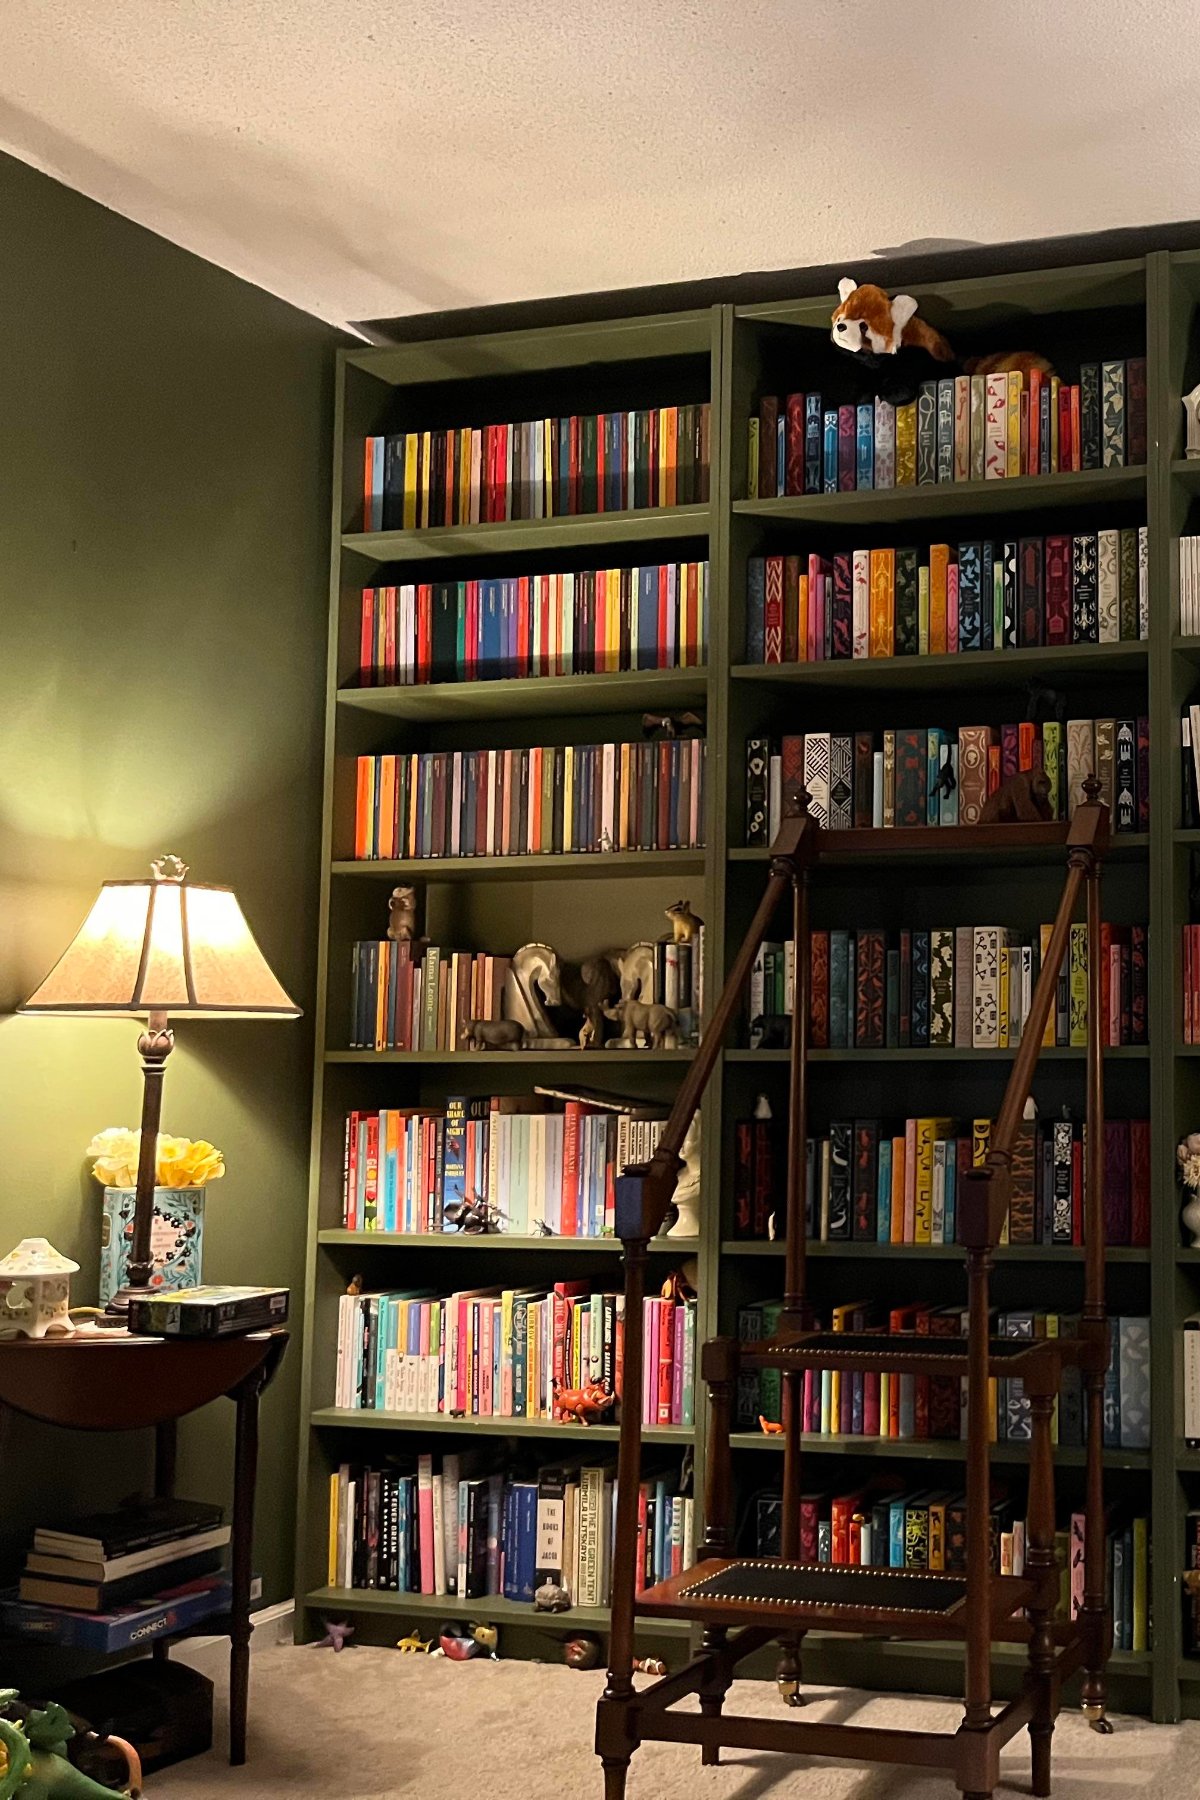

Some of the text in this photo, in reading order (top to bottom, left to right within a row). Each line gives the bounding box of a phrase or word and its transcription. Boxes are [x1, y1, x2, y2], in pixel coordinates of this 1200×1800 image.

[427, 950, 437, 1012] Mama Leone
[547, 1508, 555, 1516] THE
[587, 1580, 595, 1601] TENT
[130, 1618, 167, 1640] CONNECT
